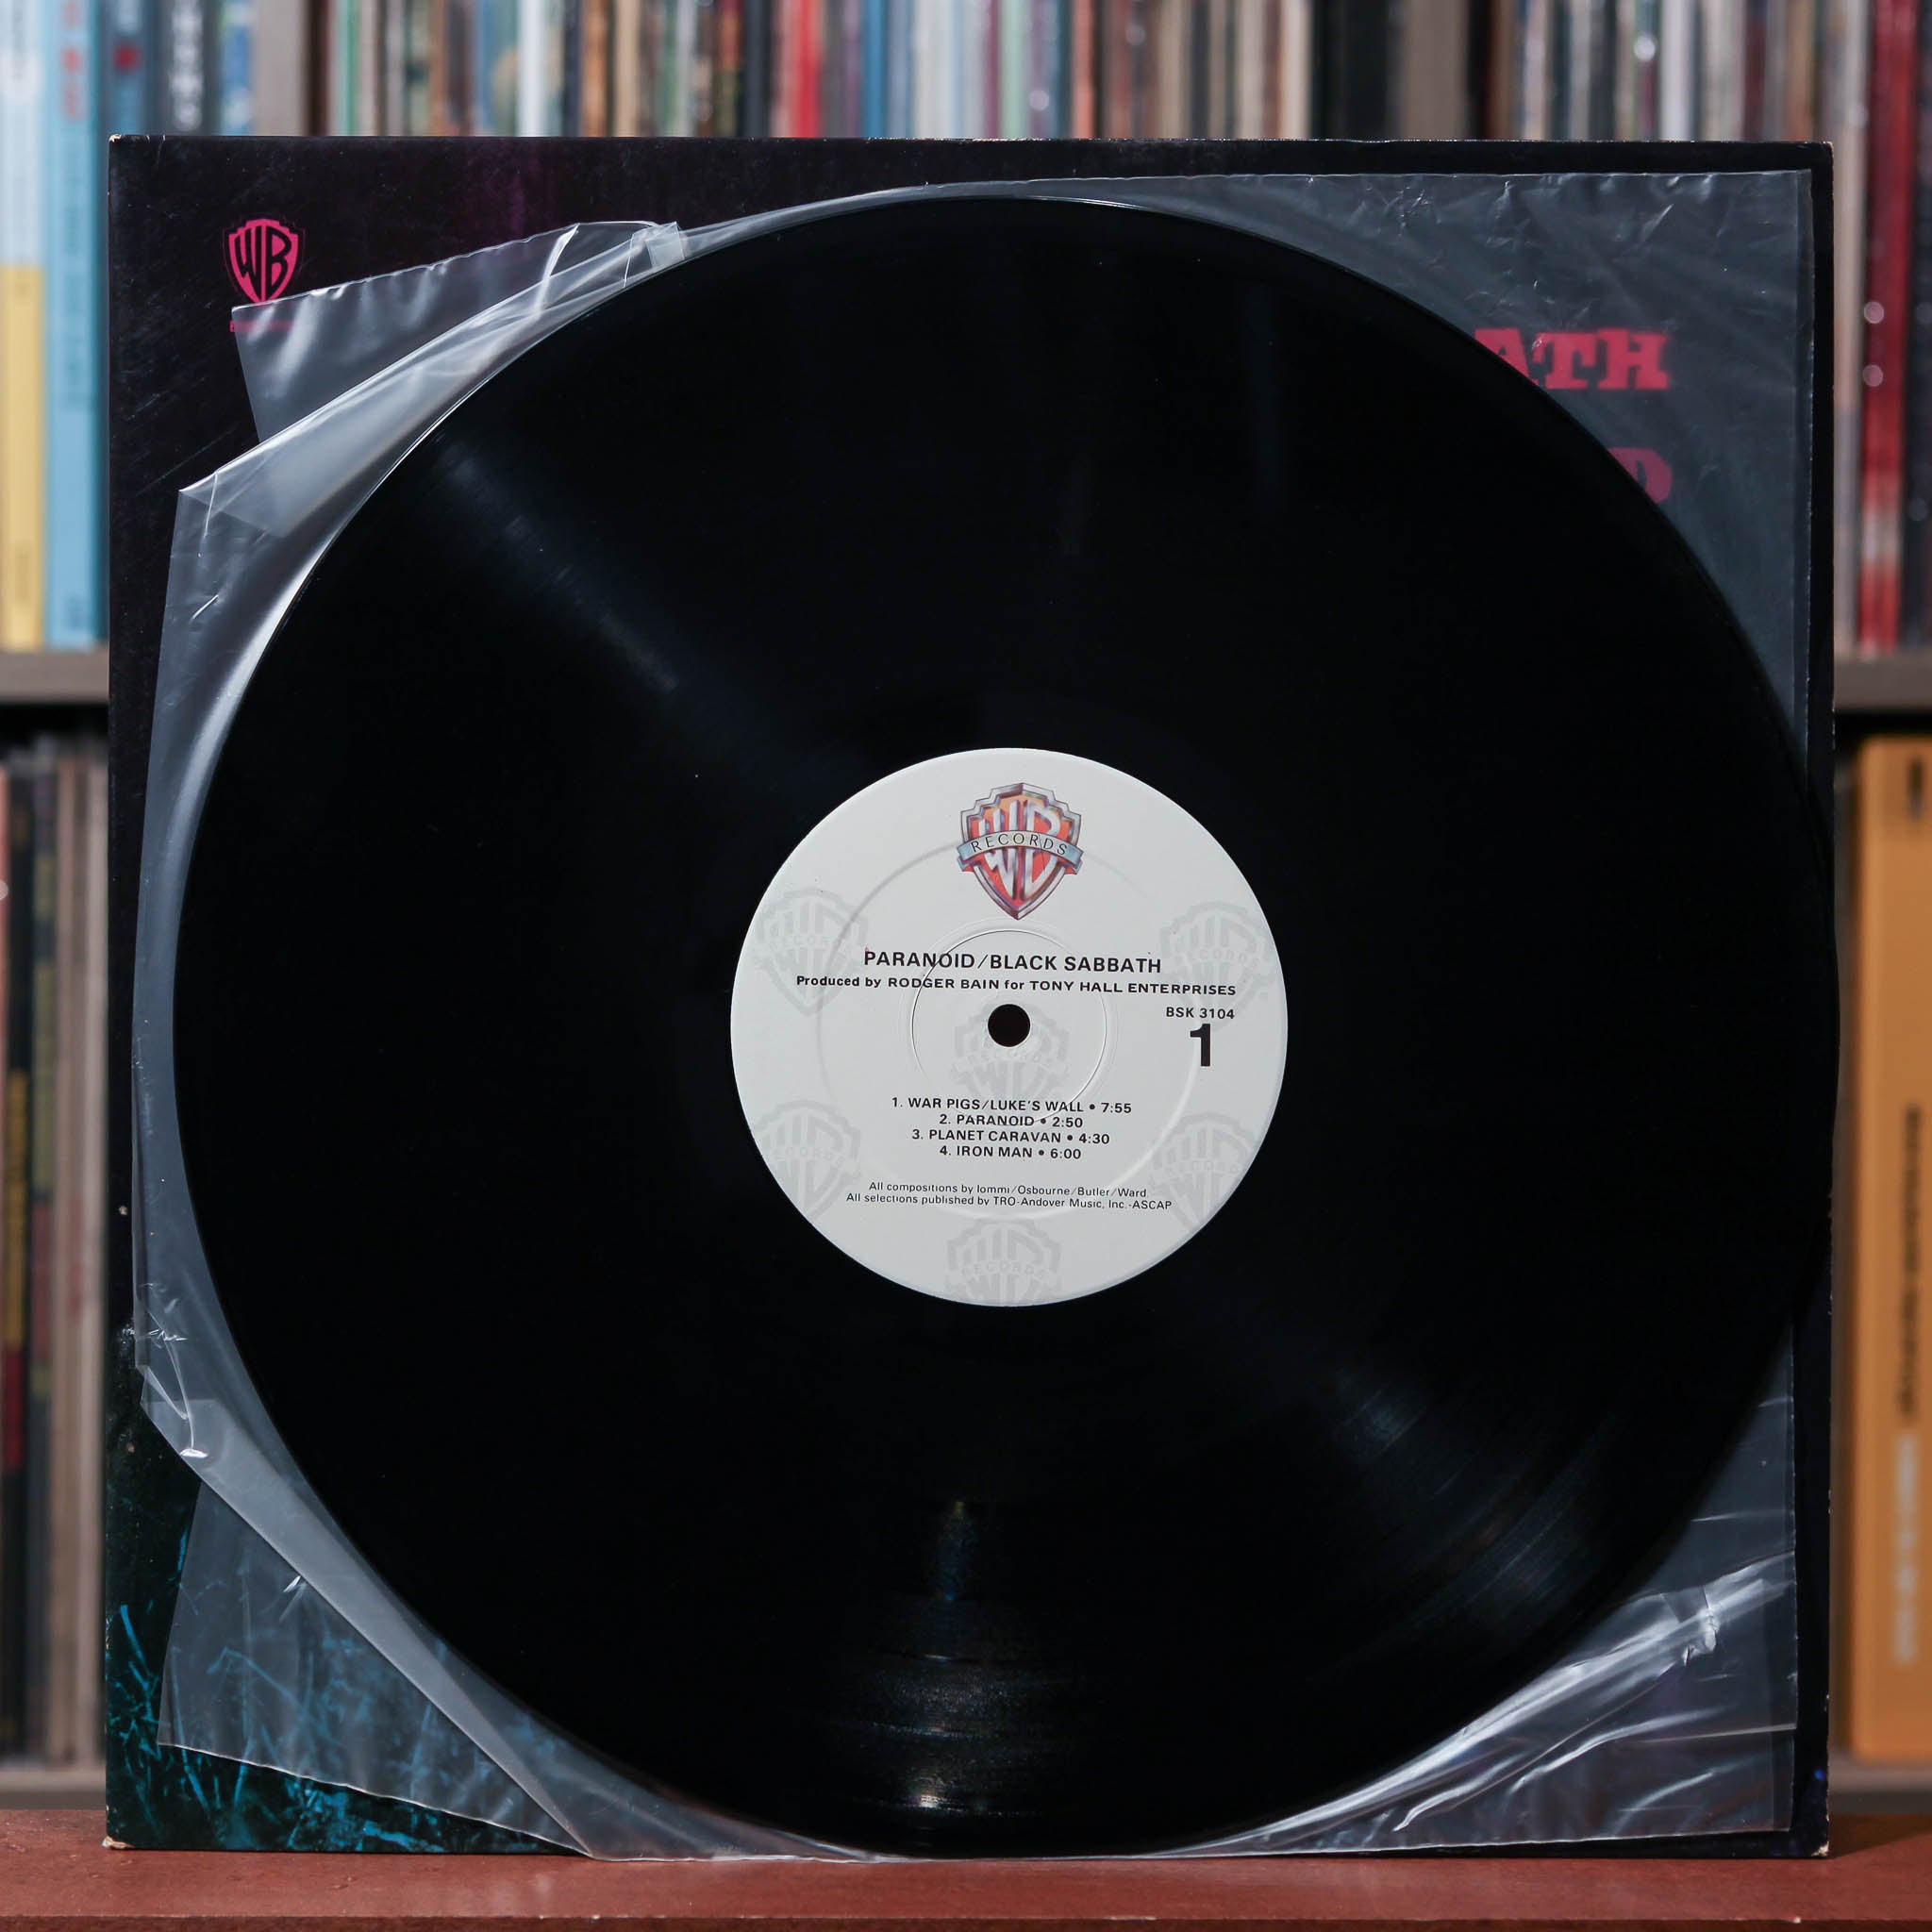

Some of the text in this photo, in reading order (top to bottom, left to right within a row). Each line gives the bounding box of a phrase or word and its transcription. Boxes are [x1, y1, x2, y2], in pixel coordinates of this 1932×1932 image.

[233, 225, 292, 301] WB
[970, 832, 1068, 856] RECORDS
[864, 950, 1161, 974] PARANOID/BLACK SABBATH
[796, 974, 1237, 996] Produced by RODGER BAIN for TONY HALL ENTERPRISES
[1165, 1006, 1235, 1020] BSK 3104
[1190, 1023, 1211, 1067] 1
[891, 1096, 1132, 1114] 1. WAR PIGS/LUKE'S WALL 7:55
[939, 1113, 1084, 1128] 2. PARANOID 2:50
[911, 1128, 1110, 1145] 3. PLANET CARAVAN 4:30
[939, 1144, 1082, 1159] 4. IRON MAN 6:00
[868, 1181, 884, 1191] All
[886, 1183, 958, 1193] compositions
[960, 1184, 974, 1195] by
[845, 1192, 861, 1203] All
[864, 1193, 919, 1204] selections
[921, 1194, 974, 1206] published
[977, 1195, 990, 1207] by
[993, 1195, 1065, 1208] TRO-Andover
[1069, 1197, 1105, 1209] Music,
